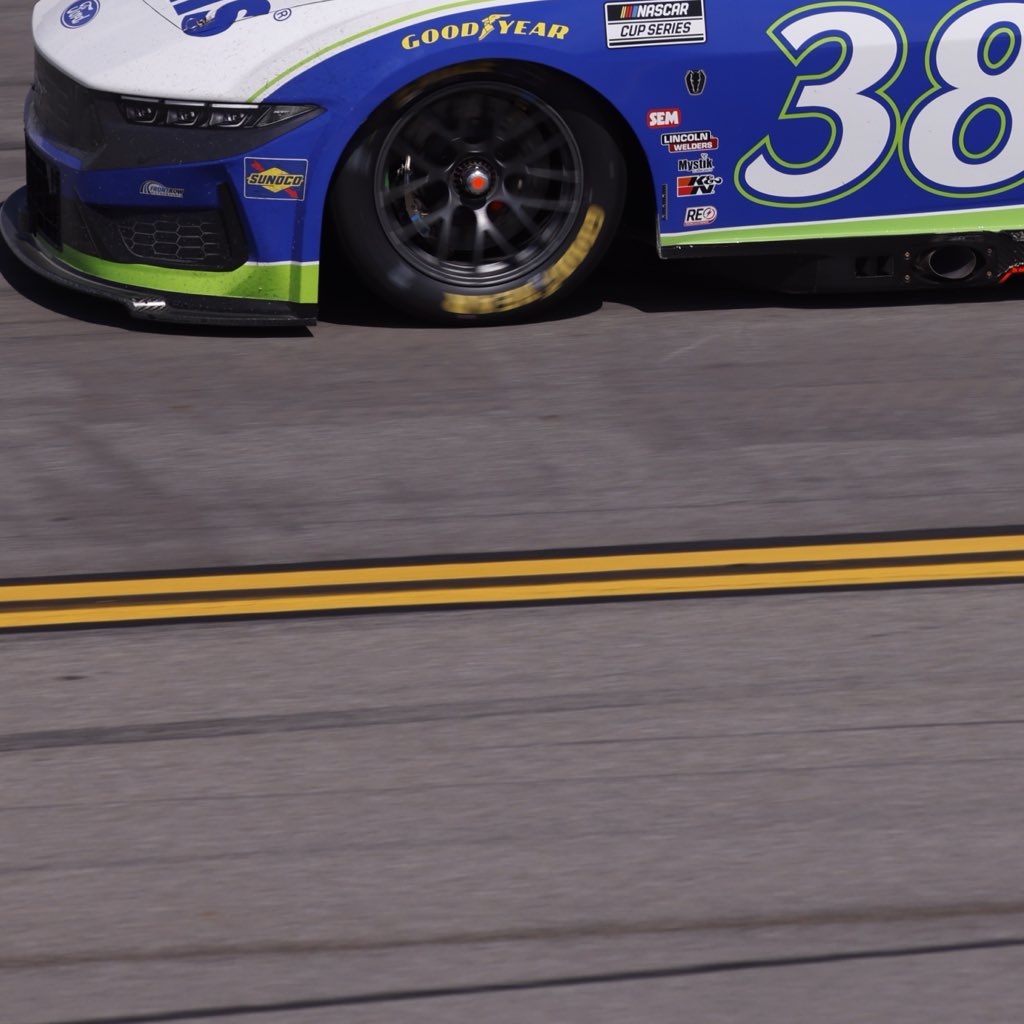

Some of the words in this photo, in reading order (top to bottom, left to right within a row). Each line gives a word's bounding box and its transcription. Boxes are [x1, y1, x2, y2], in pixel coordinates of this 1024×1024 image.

[637, 2, 689, 18] NASCAR
[620, 24, 645, 37] CUP
[647, 21, 692, 36] SERIES
[649, 110, 679, 126] SEM
[664, 132, 709, 144] LINCOLN
[673, 142, 713, 152] WELDERS
[678, 158, 713, 171] Mystik
[249, 174, 303, 186] SUNOCO
